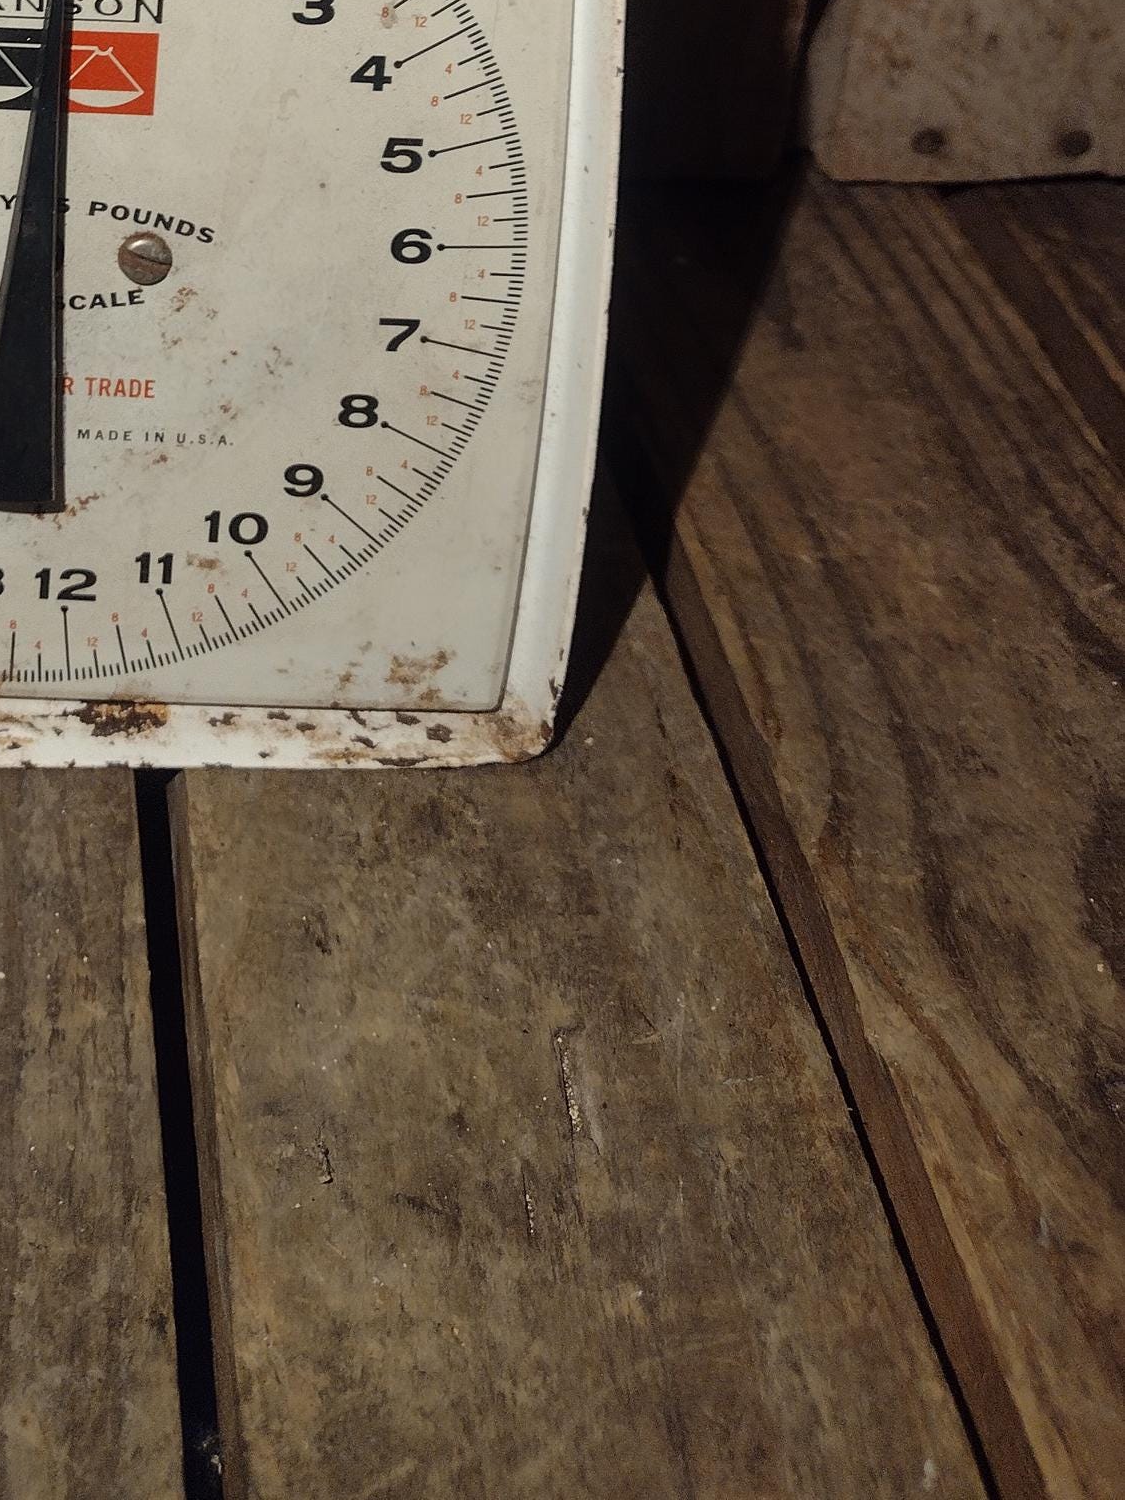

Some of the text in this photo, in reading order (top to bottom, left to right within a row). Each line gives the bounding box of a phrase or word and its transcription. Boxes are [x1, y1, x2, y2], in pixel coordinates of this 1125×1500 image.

[415, 16, 427, 27] 12
[351, 56, 392, 91] 4
[445, 63, 452, 74] 4
[431, 96, 439, 107] 8
[460, 114, 472, 125] 12
[381, 138, 423, 173] 5
[475, 165, 482, 176] 4
[454, 193, 462, 204] 8
[88, 201, 216, 244] POUNDS
[478, 216, 489, 226] 12
[391, 229, 432, 264] 6
[478, 269, 485, 279] 4
[449, 292, 457, 302] 8
[465, 320, 475, 330] 12
[379, 318, 420, 351] 7
[452, 370, 459, 380] 4
[85, 377, 156, 399] TRADE
[338, 395, 378, 428] 8
[427, 416, 438, 426] 12
[77, 429, 234, 447] MADE IN U.S.A.
[401, 460, 407, 469] 4
[366, 466, 373, 476] 8
[284, 464, 323, 497] 9
[366, 495, 377, 505] 12
[205, 511, 268, 545] 10
[294, 532, 301, 542] 8
[328, 535, 335, 544] 4
[135, 552, 173, 584] 11
[286, 562, 297, 572] 12
[35, 568, 96, 601] 12
[207, 583, 215, 594] 8
[241, 588, 247, 598] 4
[112, 612, 119, 622] 8
[192, 612, 203, 622] 12
[10, 620, 17, 629] 8
[141, 628, 147, 638] 4
[35, 641, 41, 650] 4
[87, 637, 98, 647] 12
